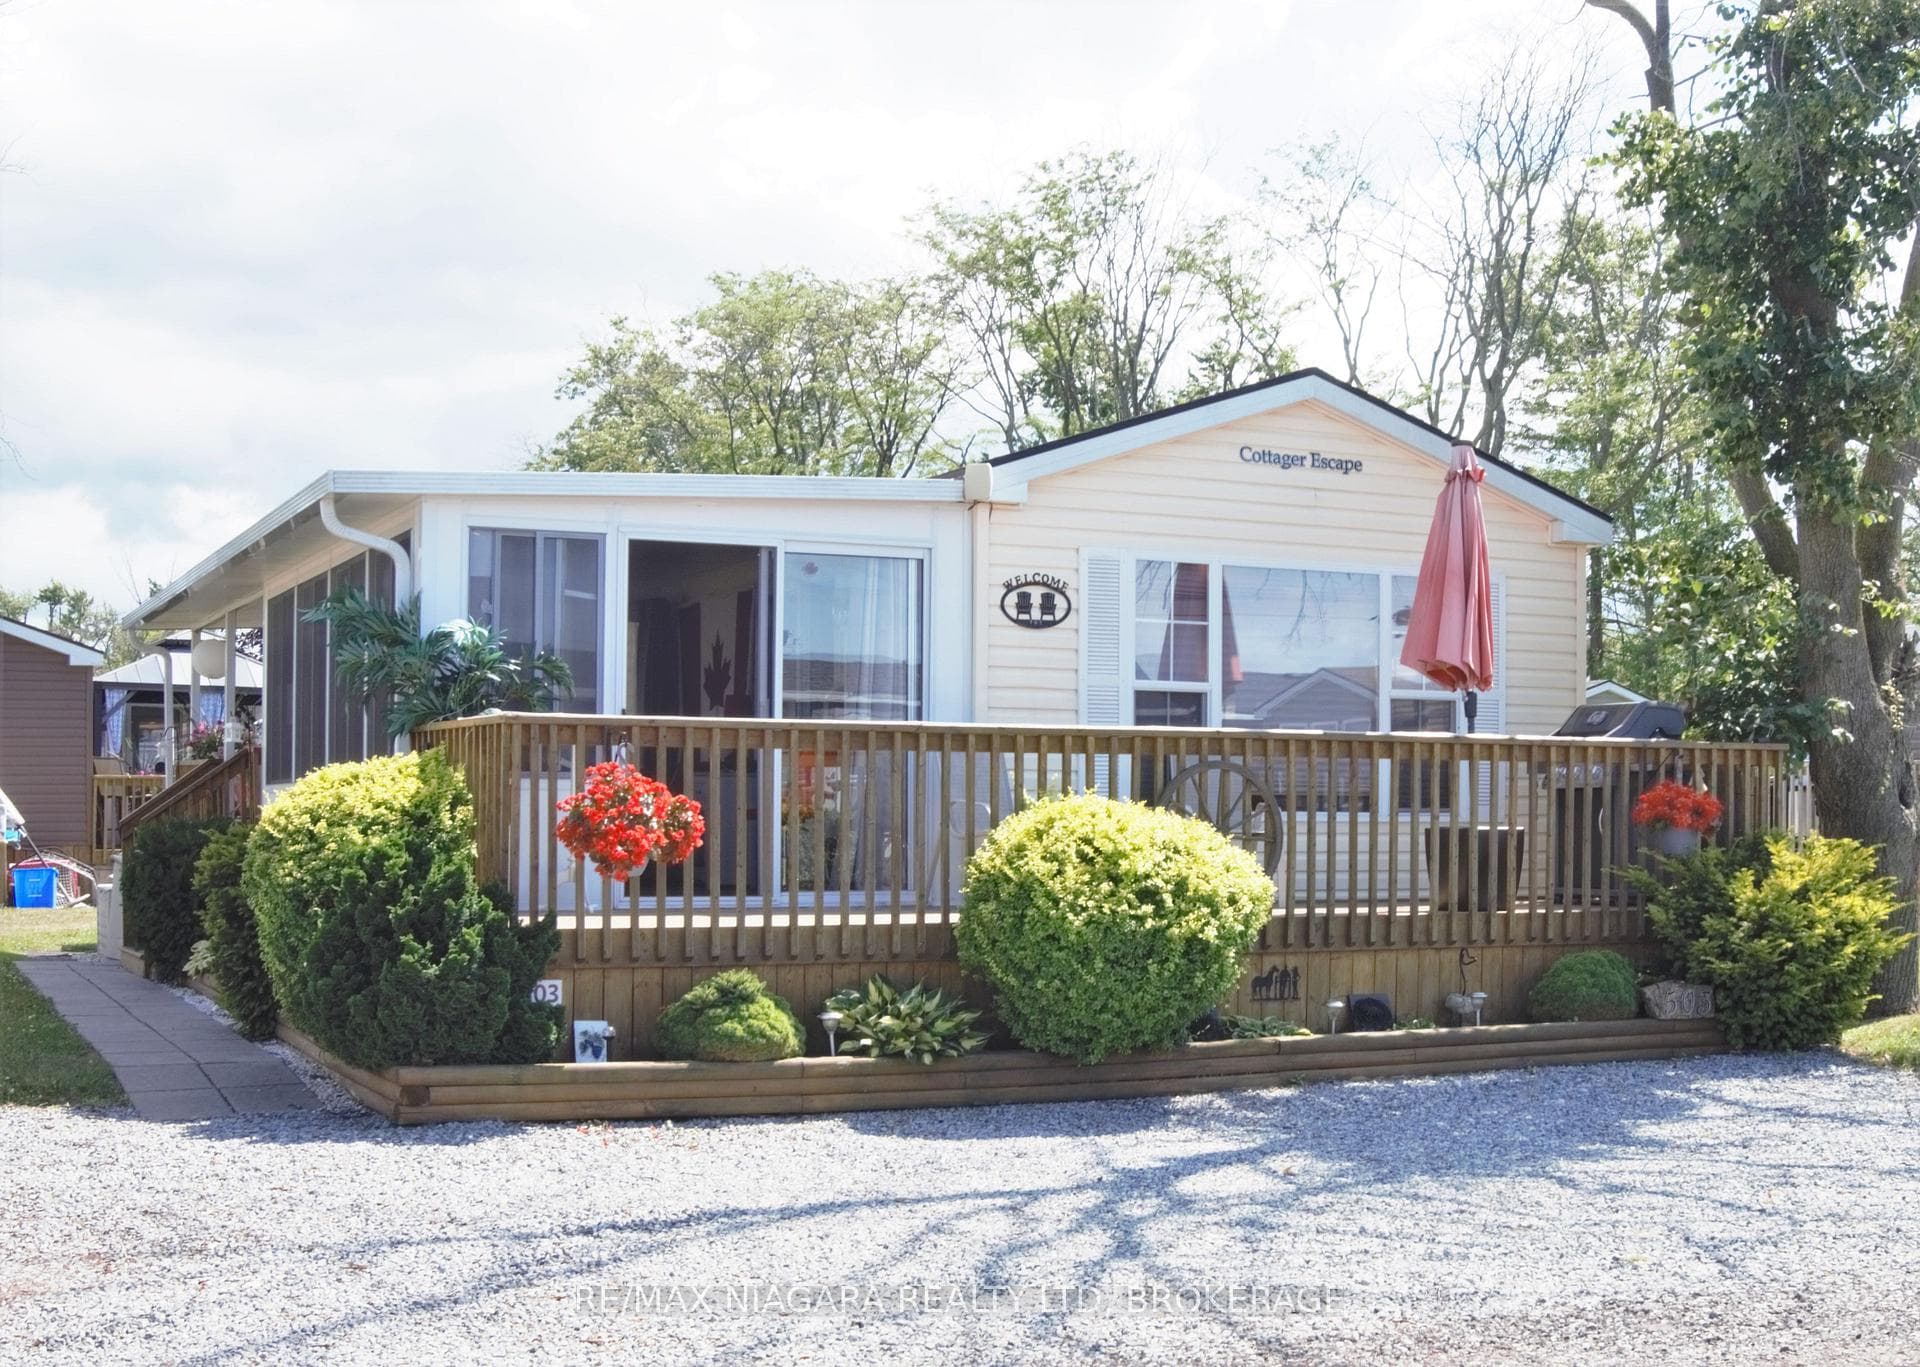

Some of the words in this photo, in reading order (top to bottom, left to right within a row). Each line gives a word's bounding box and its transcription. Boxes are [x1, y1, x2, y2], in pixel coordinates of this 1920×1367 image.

[1239, 446, 1306, 469] Cottager
[1310, 452, 1363, 474] Escape
[1002, 572, 1069, 593] WELCOME
